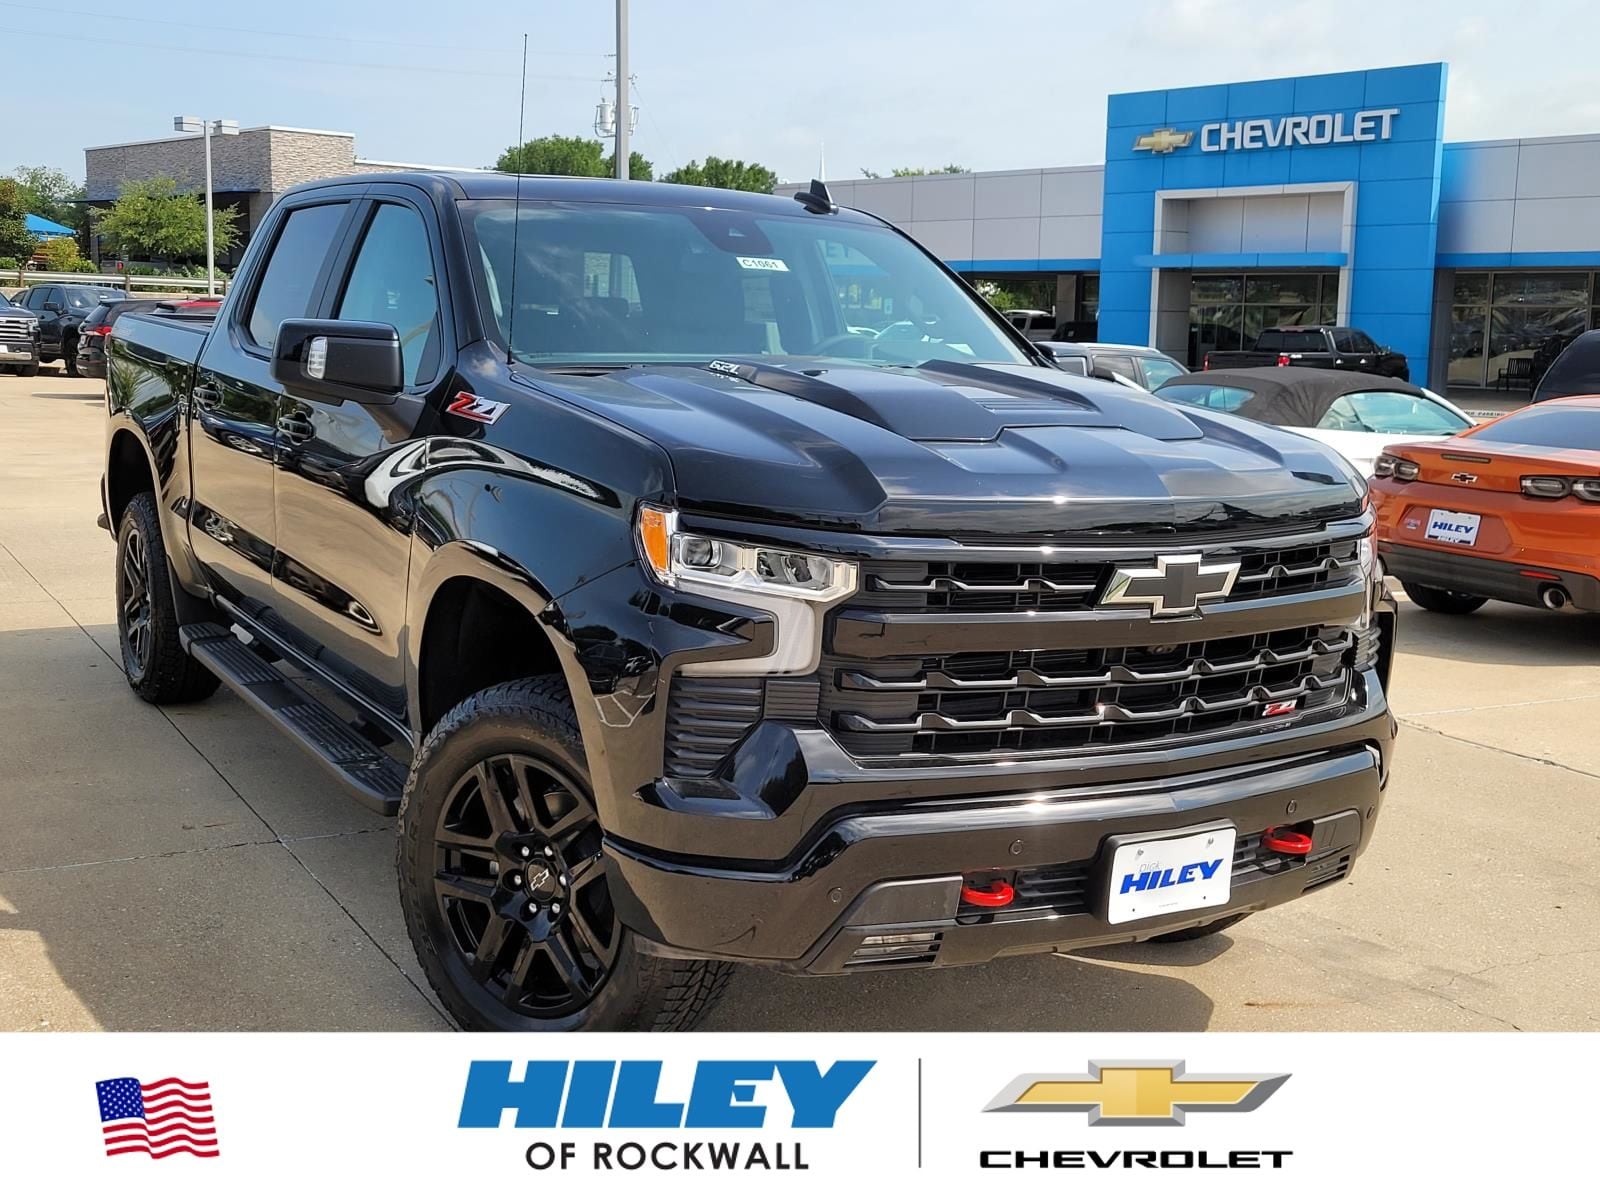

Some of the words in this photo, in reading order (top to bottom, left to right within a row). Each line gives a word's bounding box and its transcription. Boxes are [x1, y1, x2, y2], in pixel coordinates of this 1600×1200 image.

[1200, 108, 1399, 152] CHEVROLET
[1432, 521, 1474, 534] HILEY
[1120, 858, 1224, 895] HILEY
